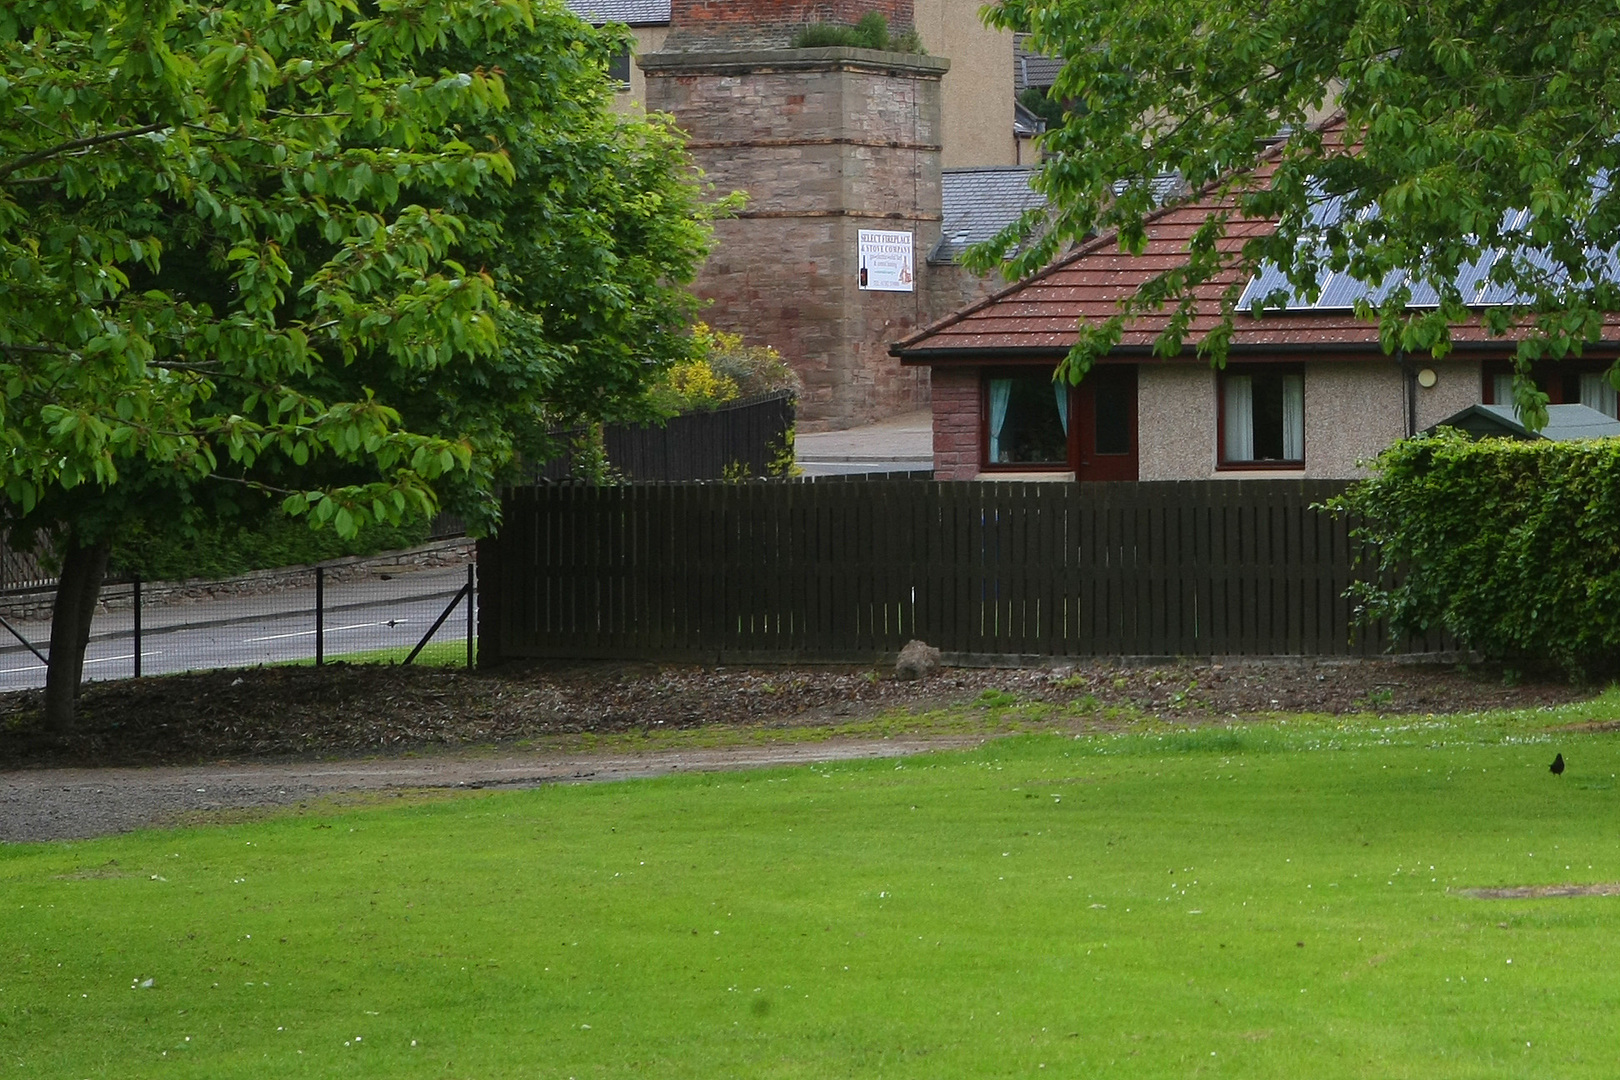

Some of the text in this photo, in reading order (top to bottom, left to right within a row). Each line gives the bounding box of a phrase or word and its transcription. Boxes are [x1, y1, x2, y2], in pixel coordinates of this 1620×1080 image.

[861, 234, 911, 244] SELECT FIREPLACE
[884, 245, 910, 254] COMPANY
